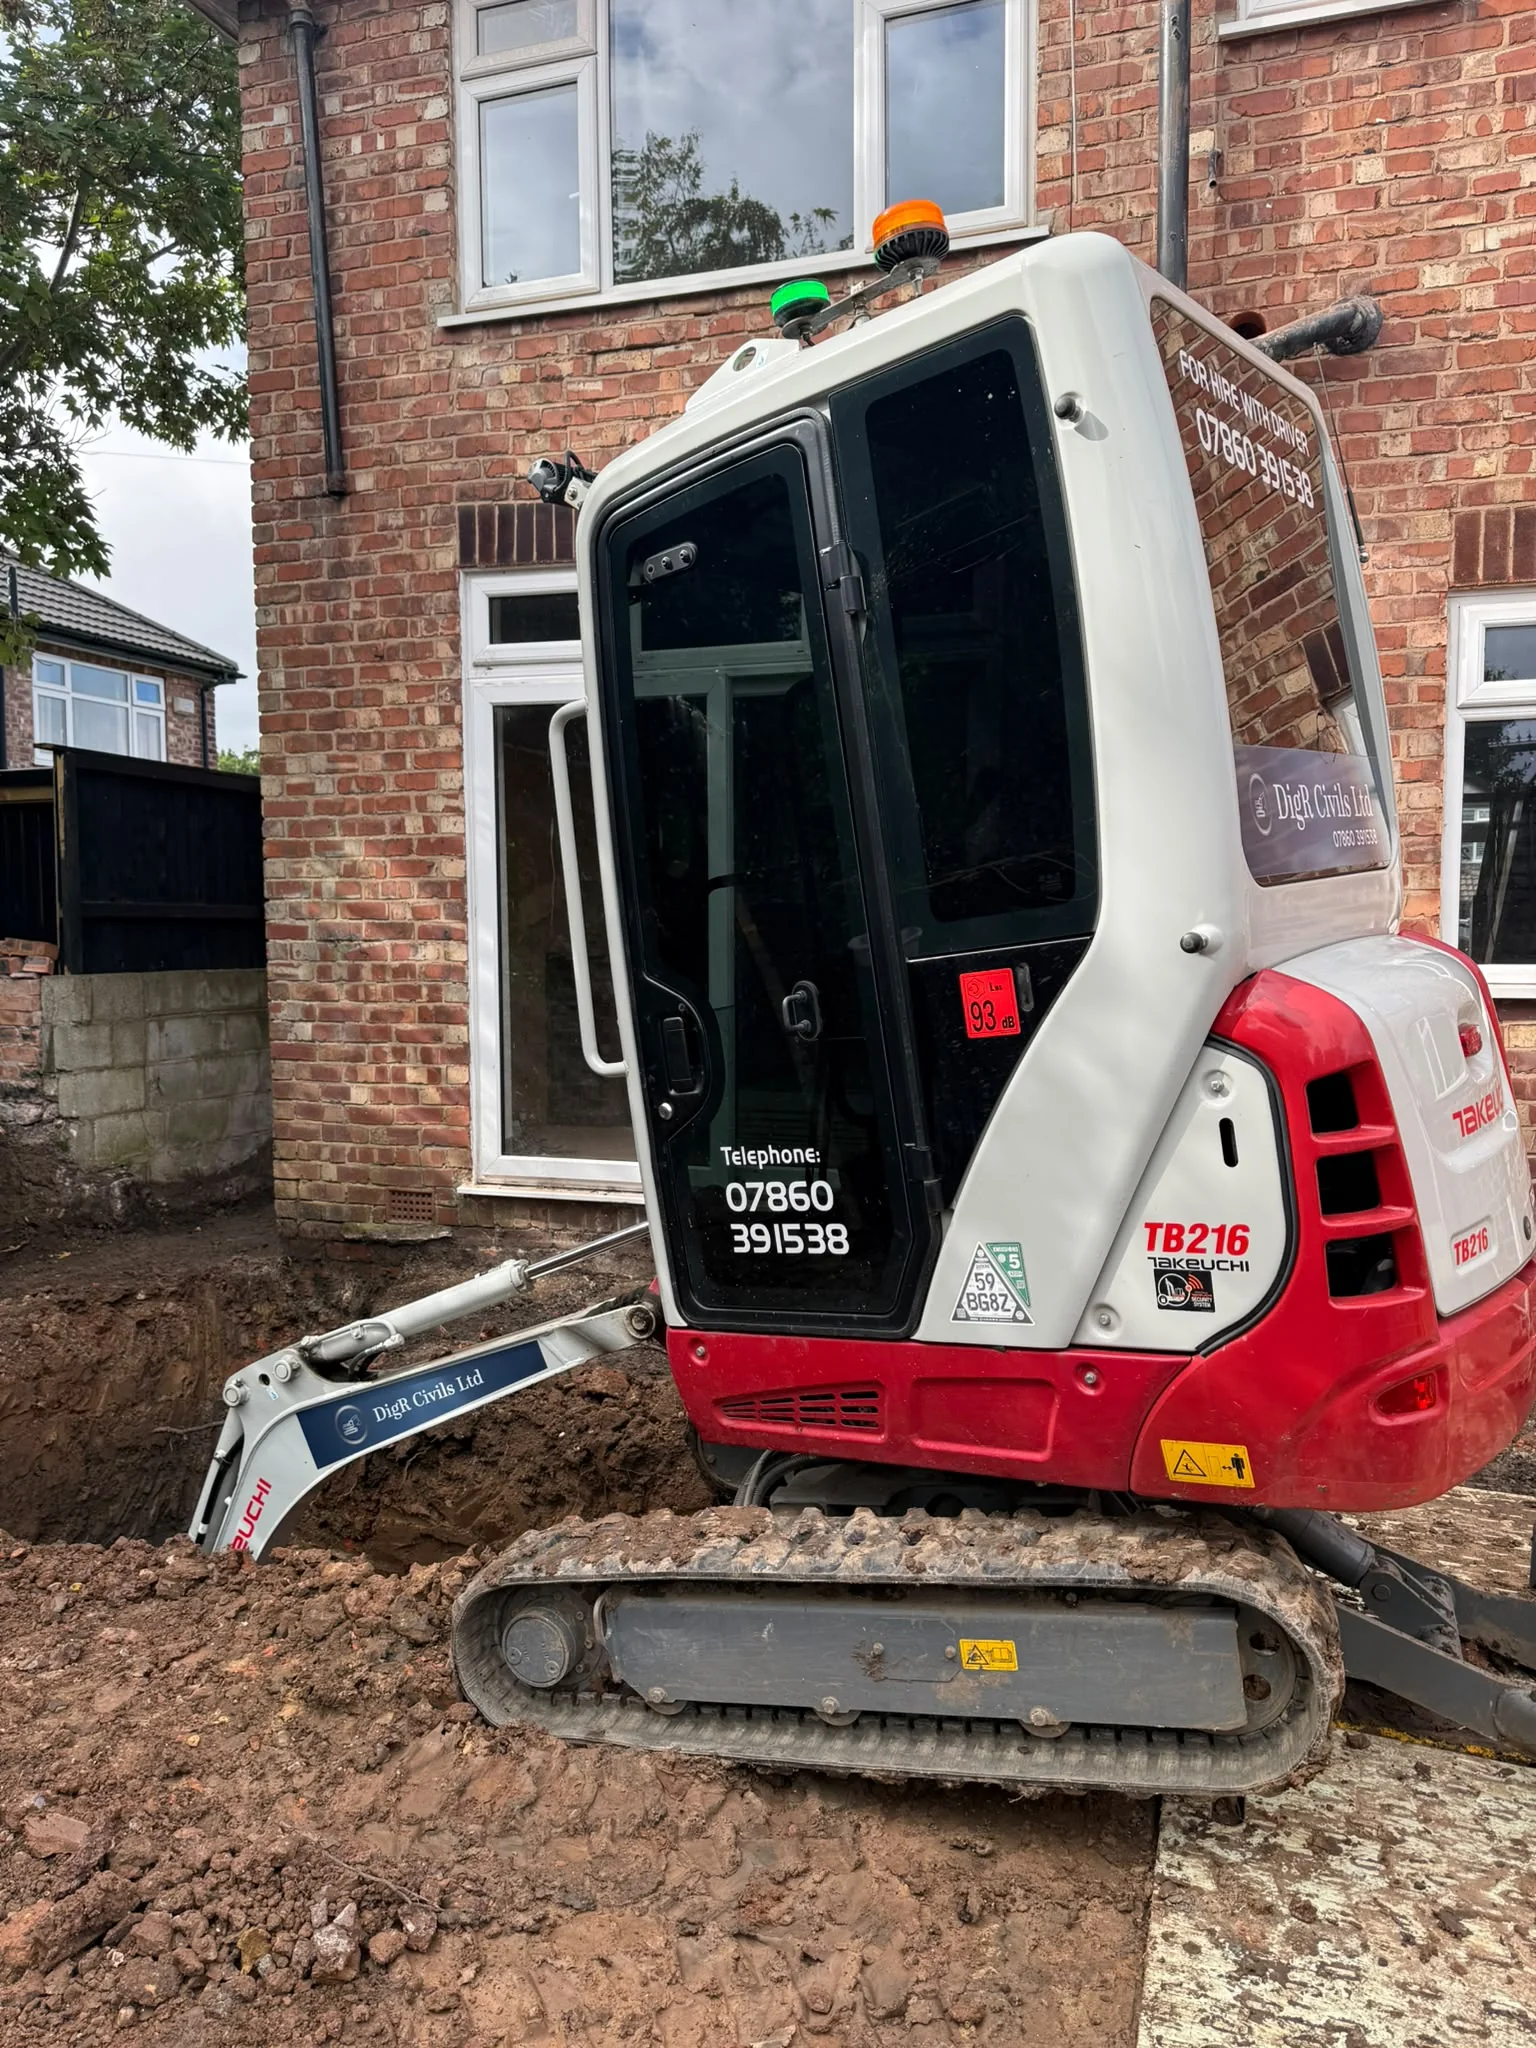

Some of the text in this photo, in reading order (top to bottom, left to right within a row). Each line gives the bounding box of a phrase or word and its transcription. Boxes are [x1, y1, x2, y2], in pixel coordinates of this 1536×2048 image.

[1179, 350, 1311, 457] FOR HIRE WITH DRIVER
[1196, 407, 1315, 509] 07860 391538
[1273, 783, 1314, 831] DigR
[1313, 783, 1351, 819] Civils
[1350, 784, 1374, 818] Ltd
[970, 1000, 1015, 1032] 93 dB
[720, 1144, 821, 1170] Telephone:
[725, 1180, 834, 1212] 07860
[730, 1223, 850, 1255] 391538
[1144, 1222, 1250, 1257] TB216
[1454, 1227, 1489, 1267] TB216
[1009, 1253, 1021, 1269] 5
[974, 1272, 995, 1291] 59
[966, 1292, 1012, 1312] BG8Z
[372, 1368, 484, 1423] DigR Civils Ltd
